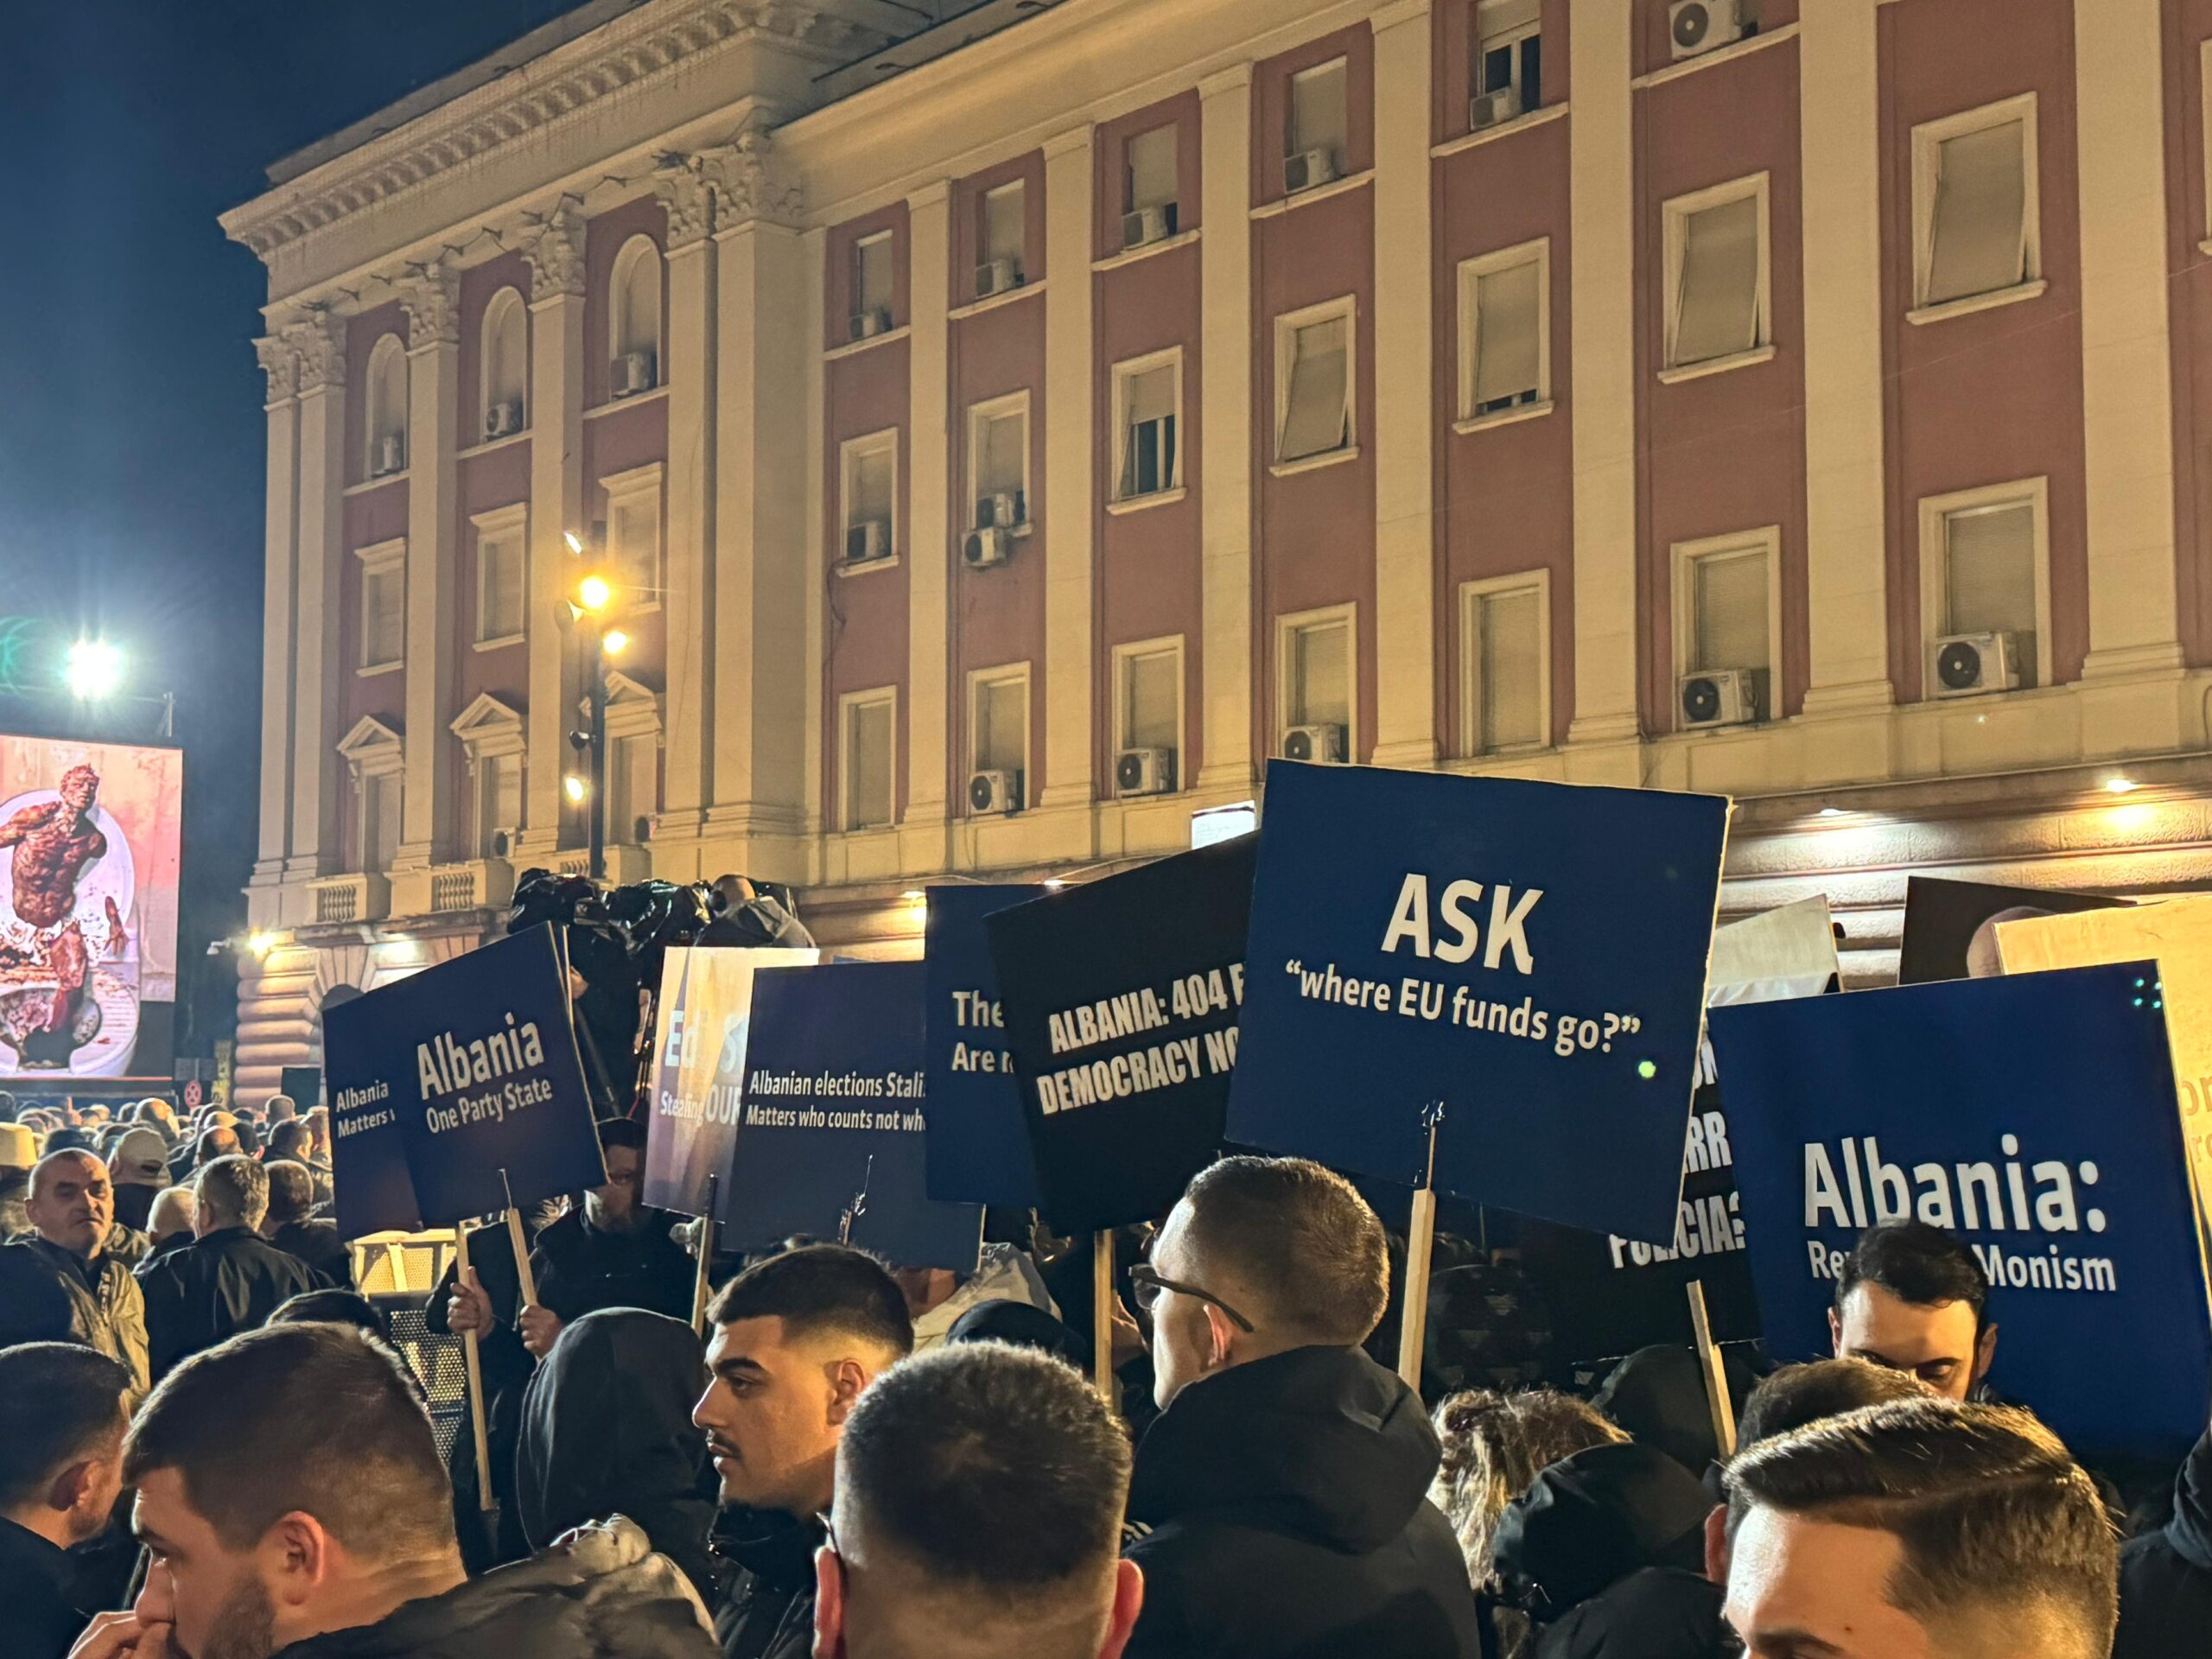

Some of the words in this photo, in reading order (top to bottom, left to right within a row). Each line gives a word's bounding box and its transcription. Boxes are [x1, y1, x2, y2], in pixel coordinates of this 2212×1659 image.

[1380, 872, 1545, 976] ASK
[1048, 988, 1170, 1054] ALBANIA:
[1173, 969, 1228, 1020] 404
[1285, 958, 1391, 1011] “where
[1398, 977, 1445, 1020] EU
[1452, 985, 1548, 1040] funds
[1554, 1011, 1642, 1057] go?”
[416, 1011, 545, 1101] Albania
[748, 1069, 812, 1096] Albanian
[814, 1070, 883, 1097] elections
[886, 1071, 926, 1098] Stali
[951, 1042, 995, 1072] Are
[1036, 1036, 1201, 1115] DEMOCRACY
[1204, 1026, 1239, 1074] NO
[337, 1110, 388, 1138] Matters
[426, 1107, 459, 1134] One
[460, 1092, 504, 1124] Party
[504, 1078, 553, 1110] State
[659, 1090, 705, 1128] Stealing
[746, 1104, 797, 1127] Matters
[798, 1104, 825, 1128] who
[828, 1109, 874, 1129] counts
[875, 1110, 900, 1130] not
[902, 1107, 926, 1132] wh
[1804, 1134, 2106, 1233] Albania:
[1971, 1243, 2116, 1291] Monism
